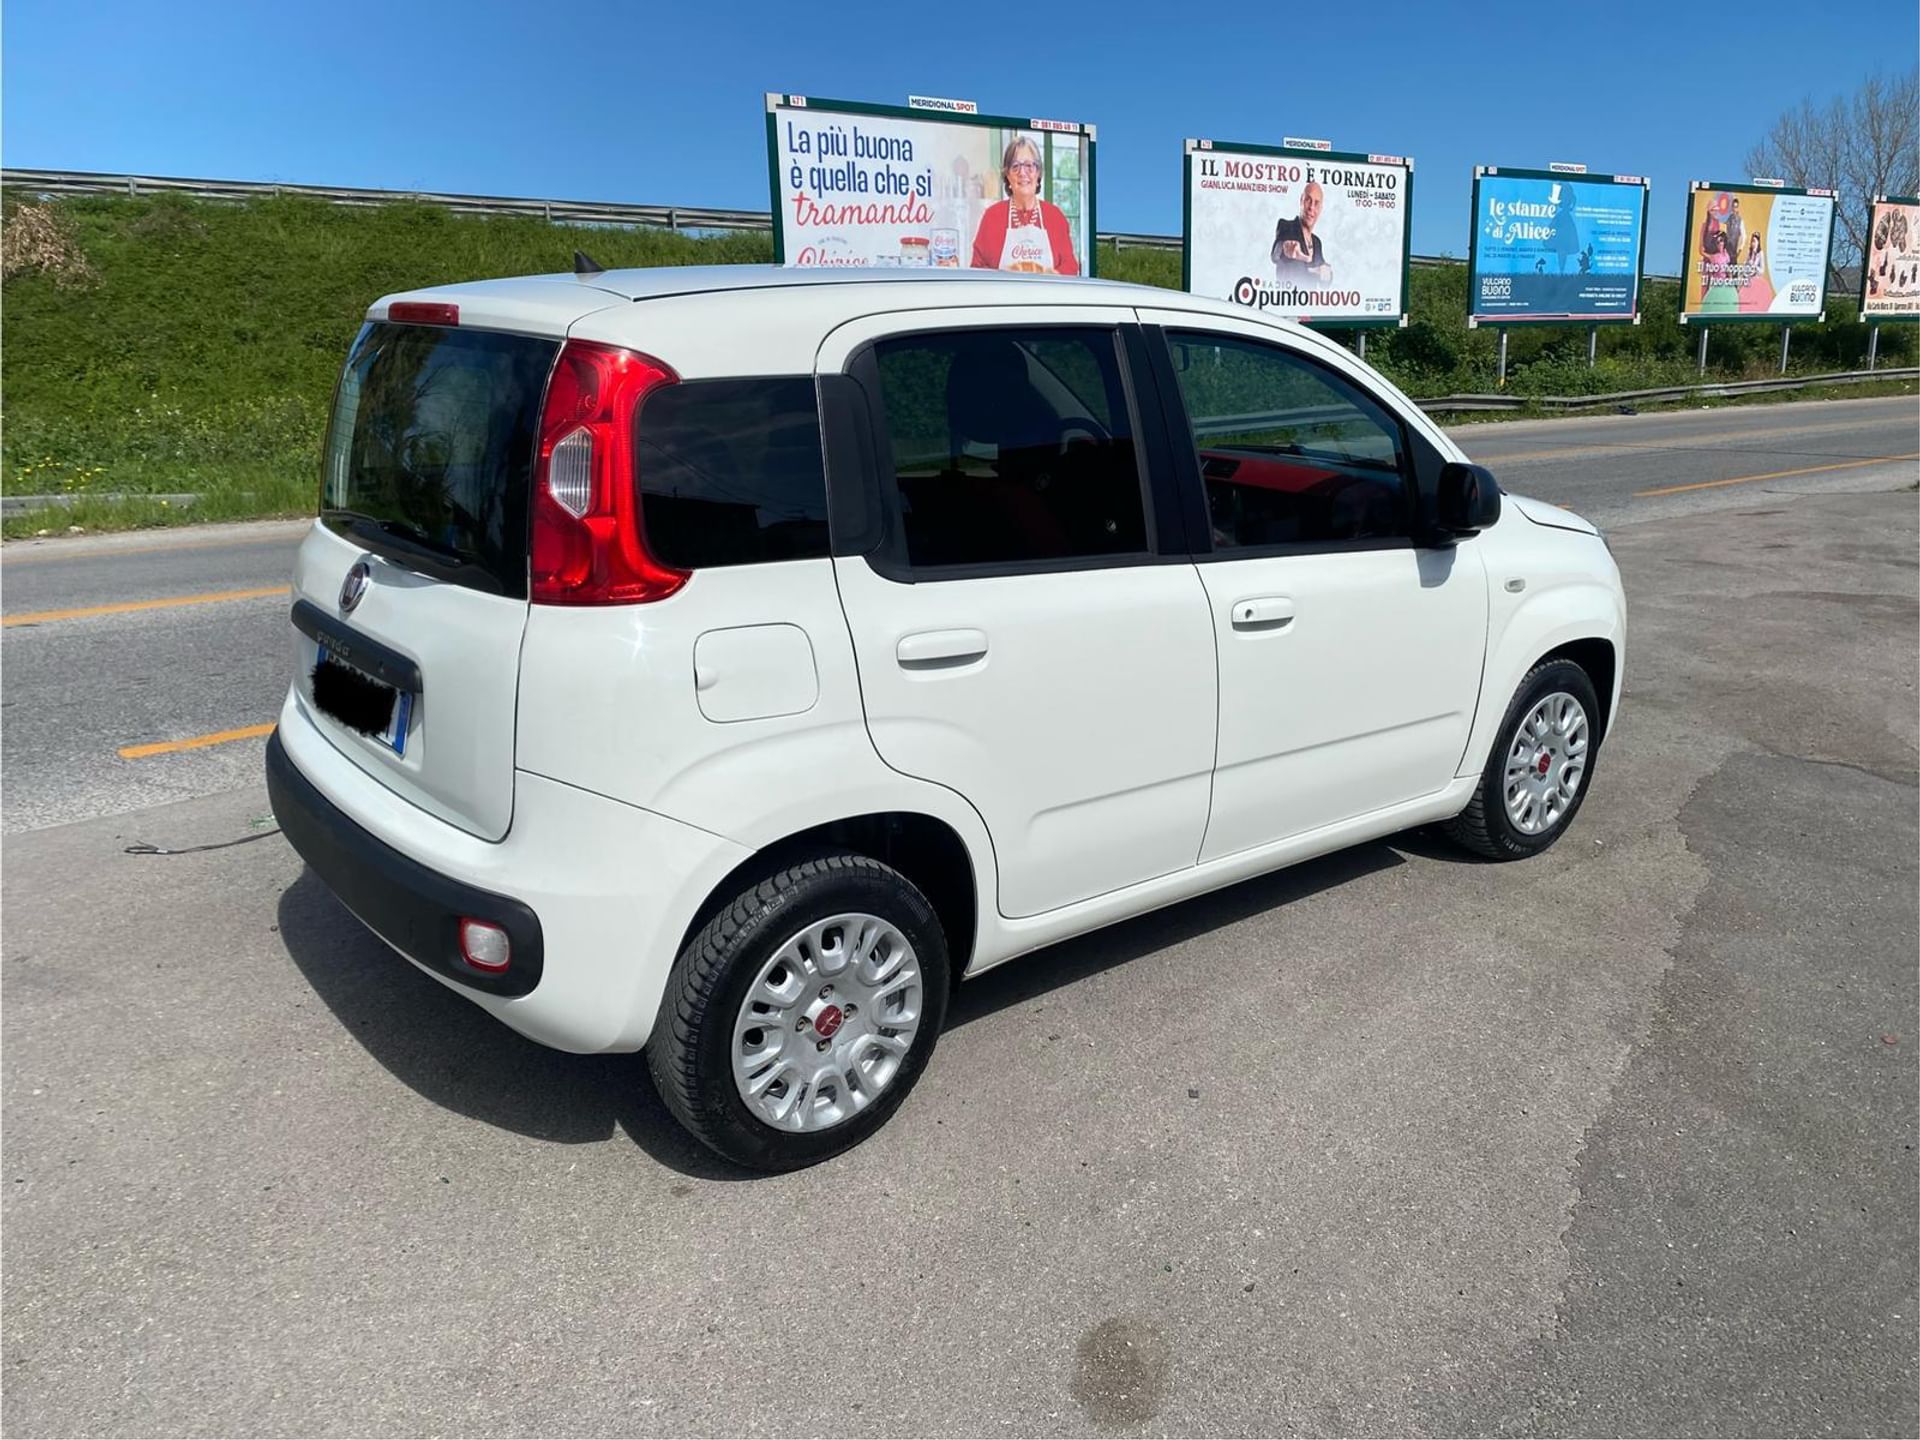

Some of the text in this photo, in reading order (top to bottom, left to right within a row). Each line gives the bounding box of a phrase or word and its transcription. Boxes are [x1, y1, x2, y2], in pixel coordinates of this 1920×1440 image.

[788, 121, 913, 163] La più buona
[791, 161, 932, 198] è quella che si
[1200, 180, 1288, 194] GIANLUCA MANZIERI SHOW
[1201, 159, 1396, 190] IL MOSTRO È TORNATO
[791, 190, 934, 226] tramanda
[1488, 198, 1506, 225] Le
[1507, 200, 1556, 218] stanze
[1492, 222, 1556, 244] di Alice
[1697, 262, 1704, 272] Il
[1706, 263, 1719, 272] tuo
[1702, 277, 1708, 286] Il
[1710, 278, 1724, 286] tuo
[1258, 285, 1360, 309] puntonuovo
